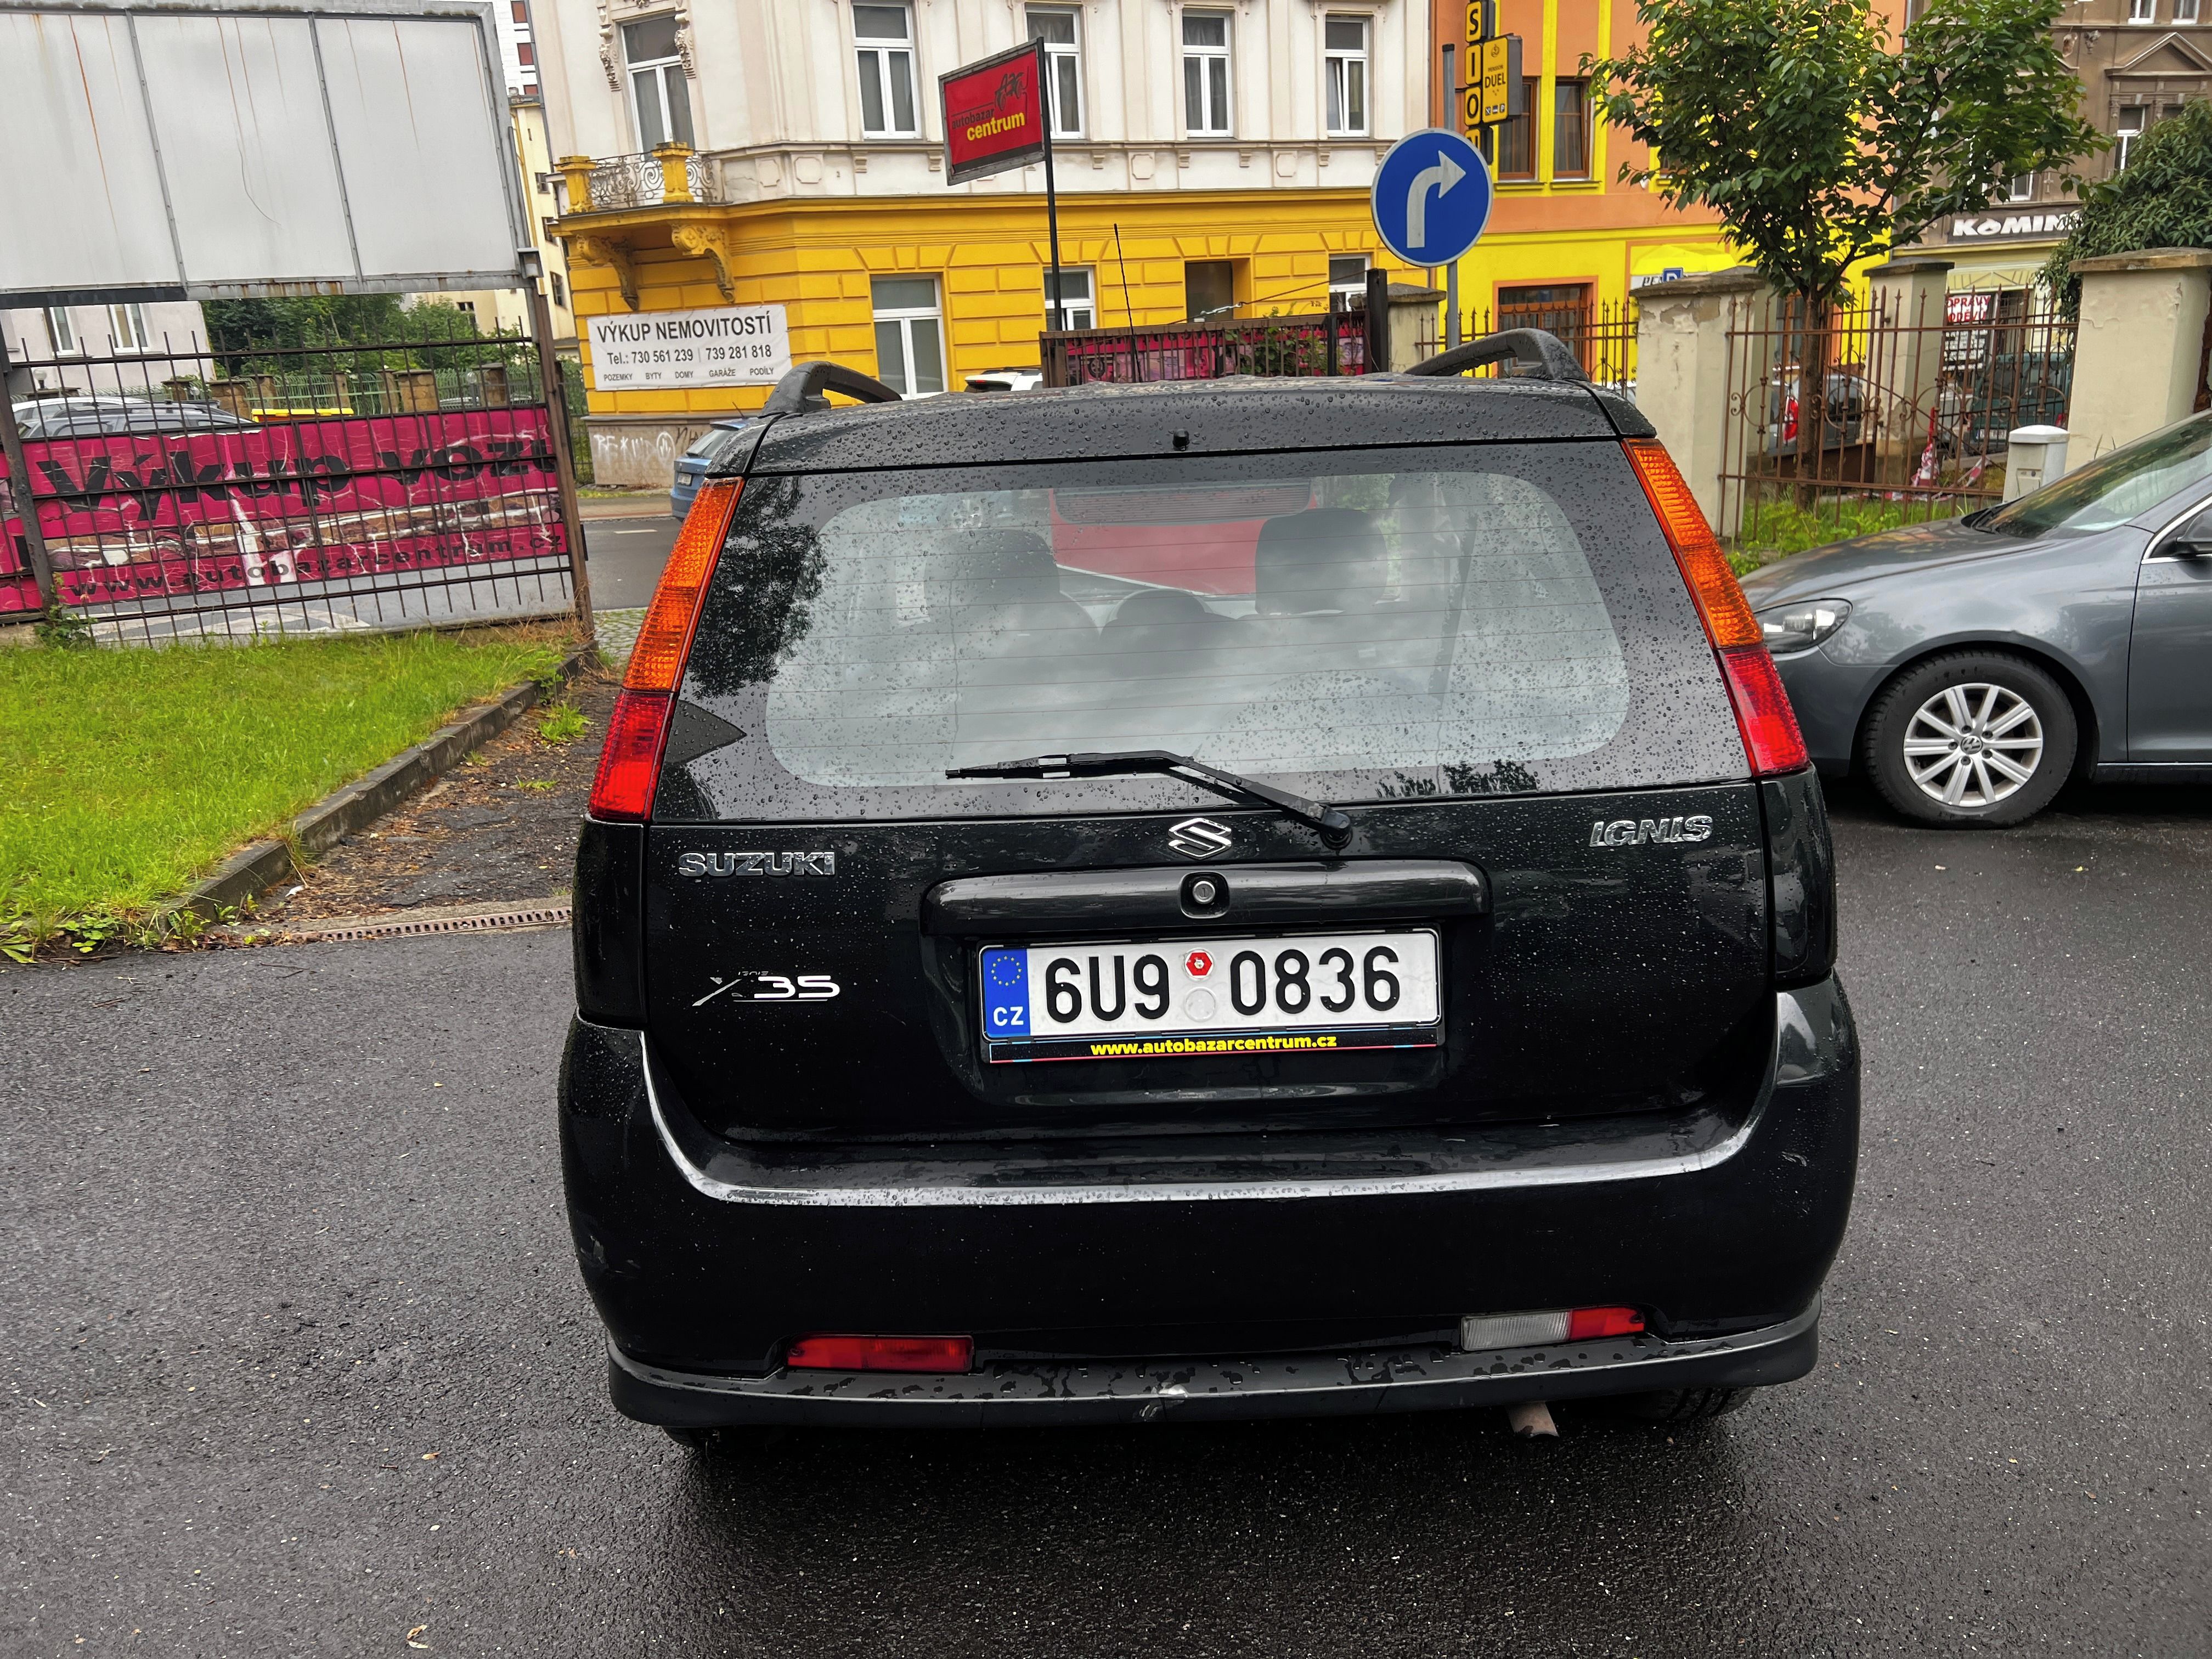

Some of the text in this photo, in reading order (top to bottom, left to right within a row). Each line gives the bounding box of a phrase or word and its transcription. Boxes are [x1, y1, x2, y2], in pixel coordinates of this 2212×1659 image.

[1485, 72, 1506, 88] DUEL
[952, 107, 995, 129] autobazar
[967, 112, 1025, 141] centrum
[597, 311, 772, 343] VÝKUP NEMOVITOSTÍ
[607, 345, 772, 365] Tel.: 730 561 239 739 281 818
[603, 373, 633, 381] POZEMKY
[709, 368, 736, 377] GARÁŽE
[749, 366, 774, 375] PODÍLY
[36, 450, 351, 521] Výkup
[1589, 815, 1713, 847] IGNIS
[678, 851, 836, 877] SUZUKI
[1045, 945, 1401, 1024] 6U9 0836
[993, 1006, 1024, 1027] CZ
[1091, 1034, 1337, 1057] www.autobazarcentrum.cz
